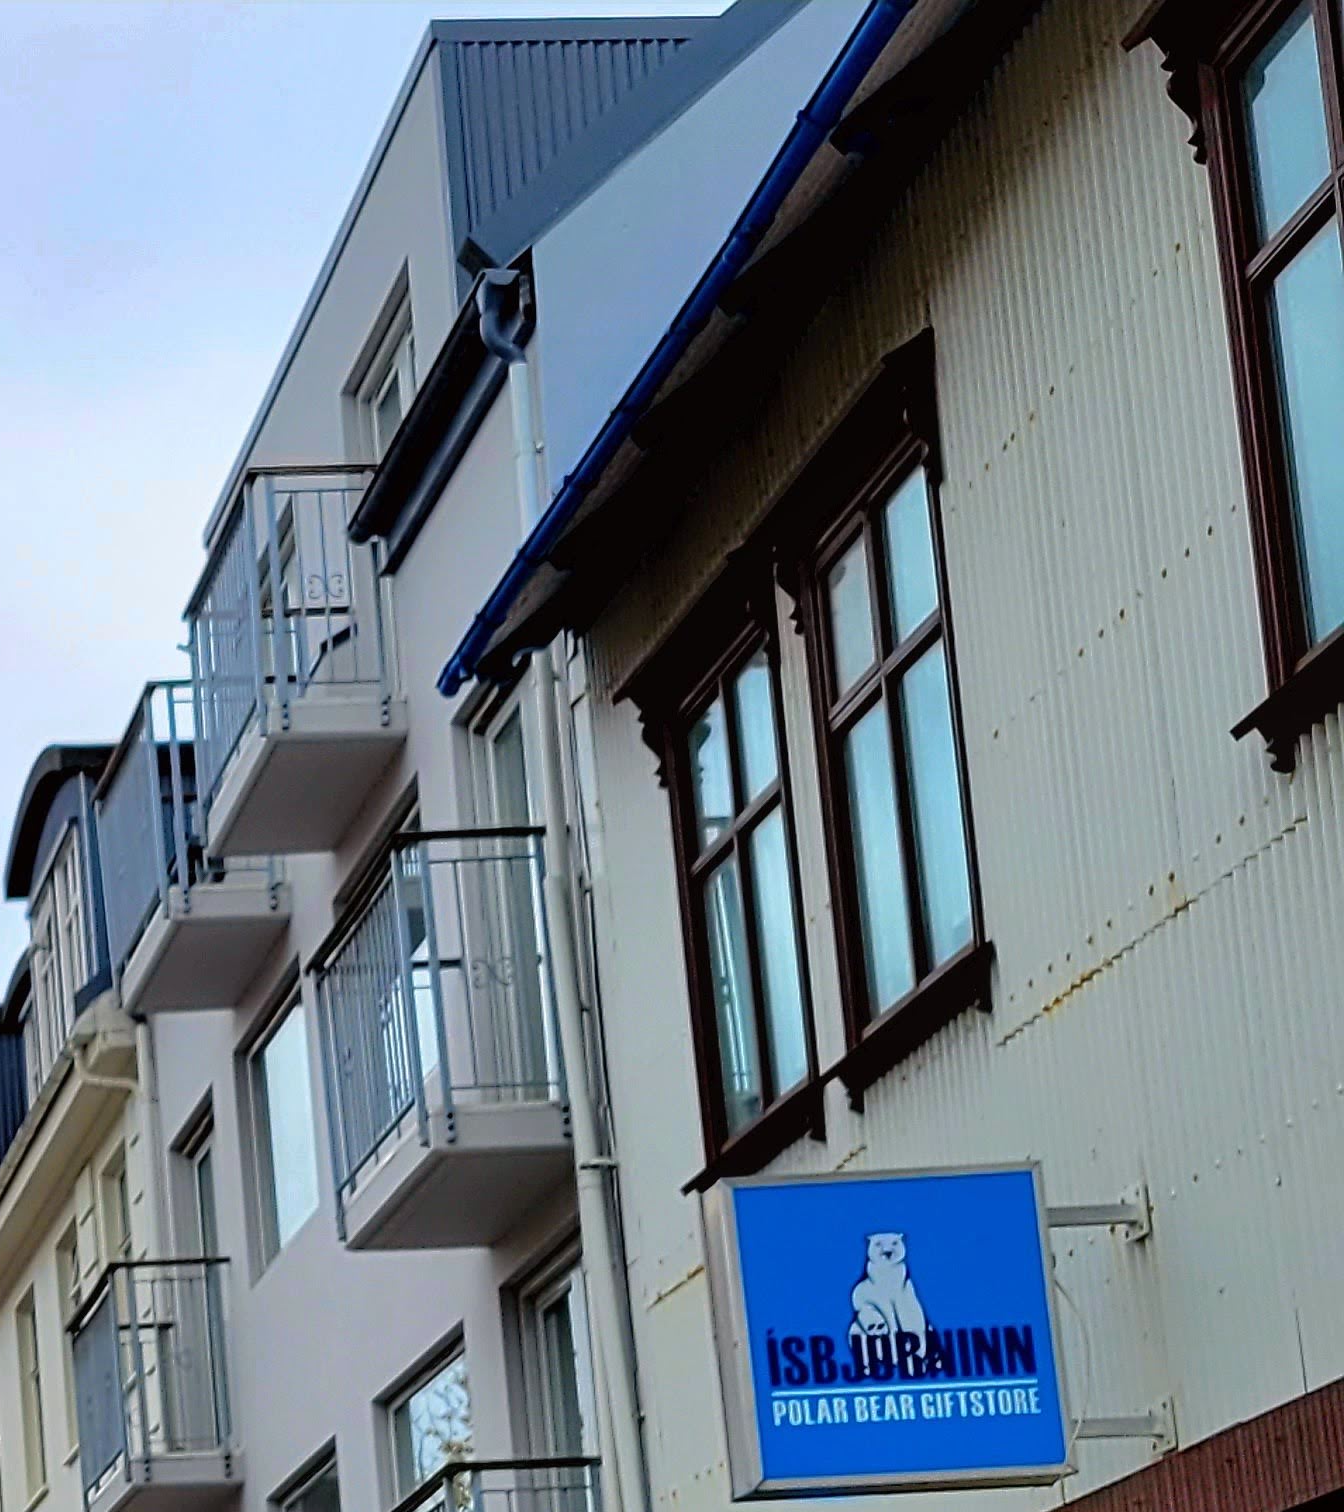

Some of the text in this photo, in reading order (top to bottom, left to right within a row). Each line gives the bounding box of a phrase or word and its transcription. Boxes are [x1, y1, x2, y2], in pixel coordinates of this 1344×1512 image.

[772, 1387, 1041, 1427] POLAR BEAR GIFTSTORE
